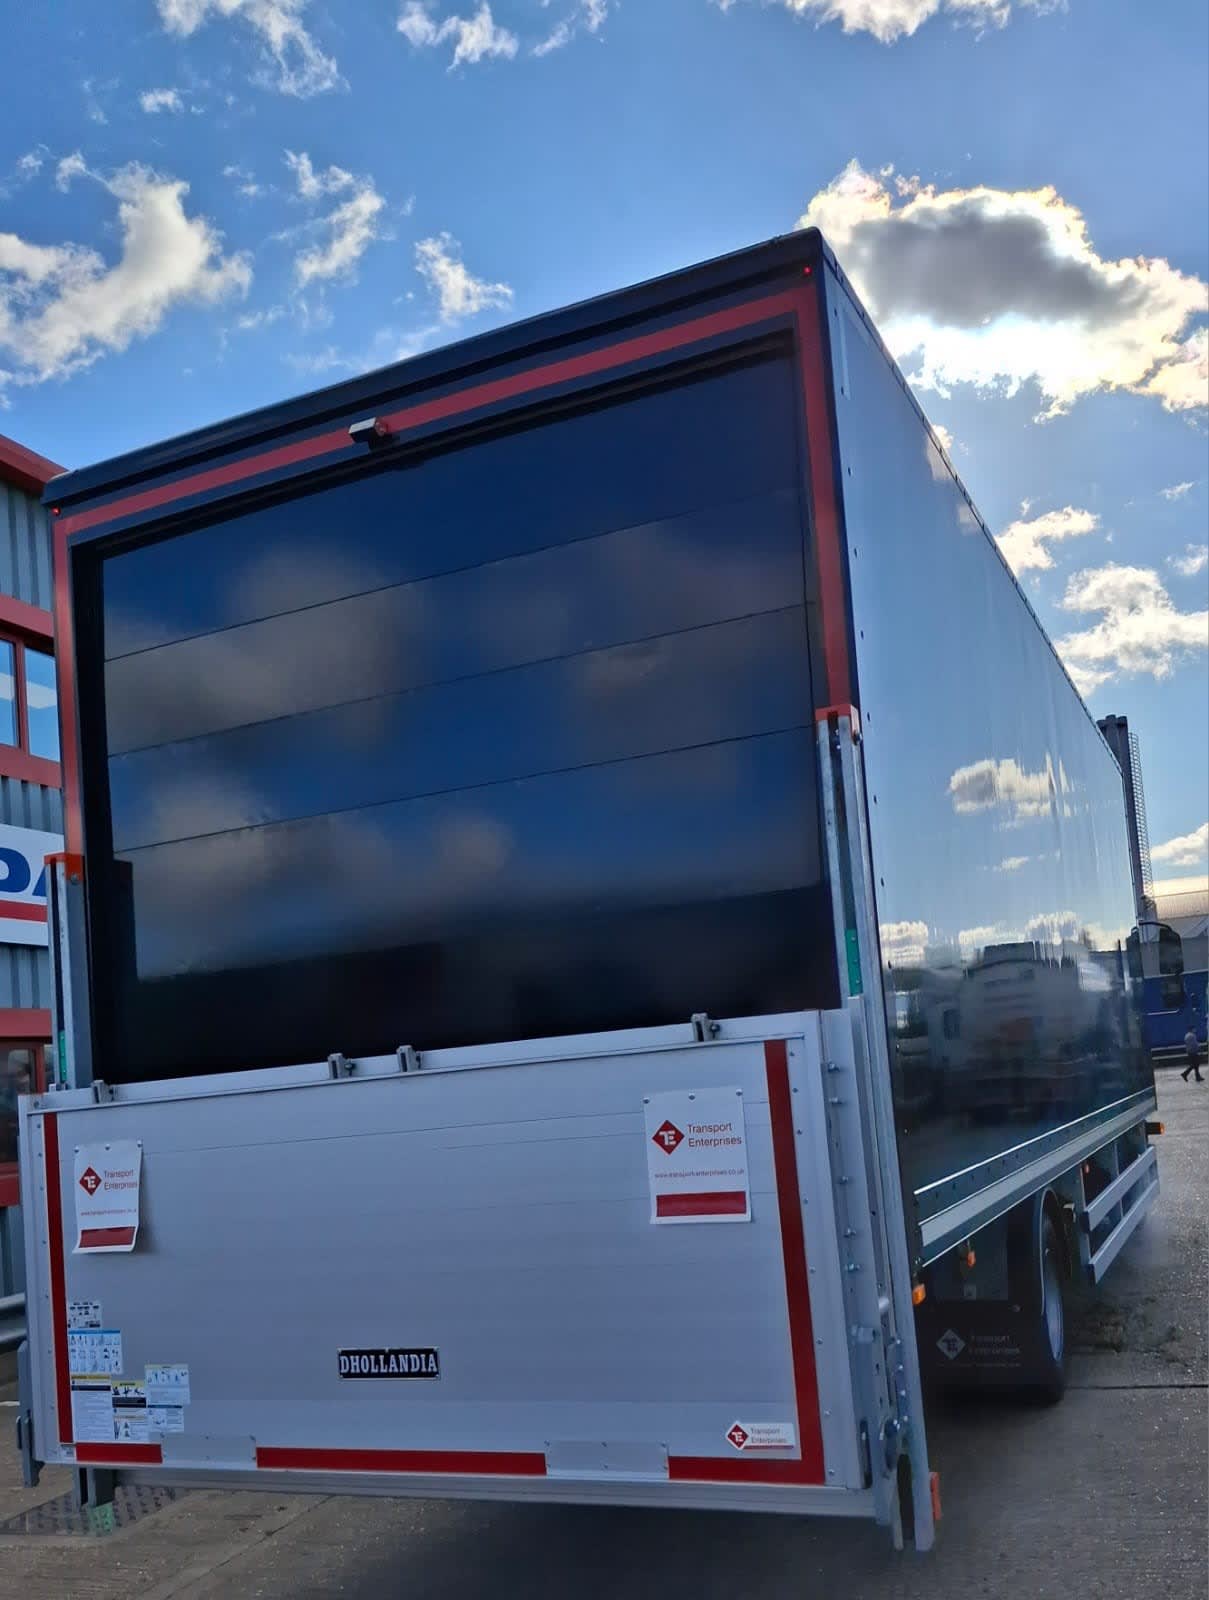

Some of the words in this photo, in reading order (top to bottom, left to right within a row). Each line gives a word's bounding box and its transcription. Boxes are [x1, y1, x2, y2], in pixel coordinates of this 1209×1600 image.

[688, 1122, 732, 1133] Transport
[688, 1136, 742, 1148] Enterprises
[104, 1169, 134, 1179] Transport
[340, 1354, 438, 1374] DHOLLANDIA
